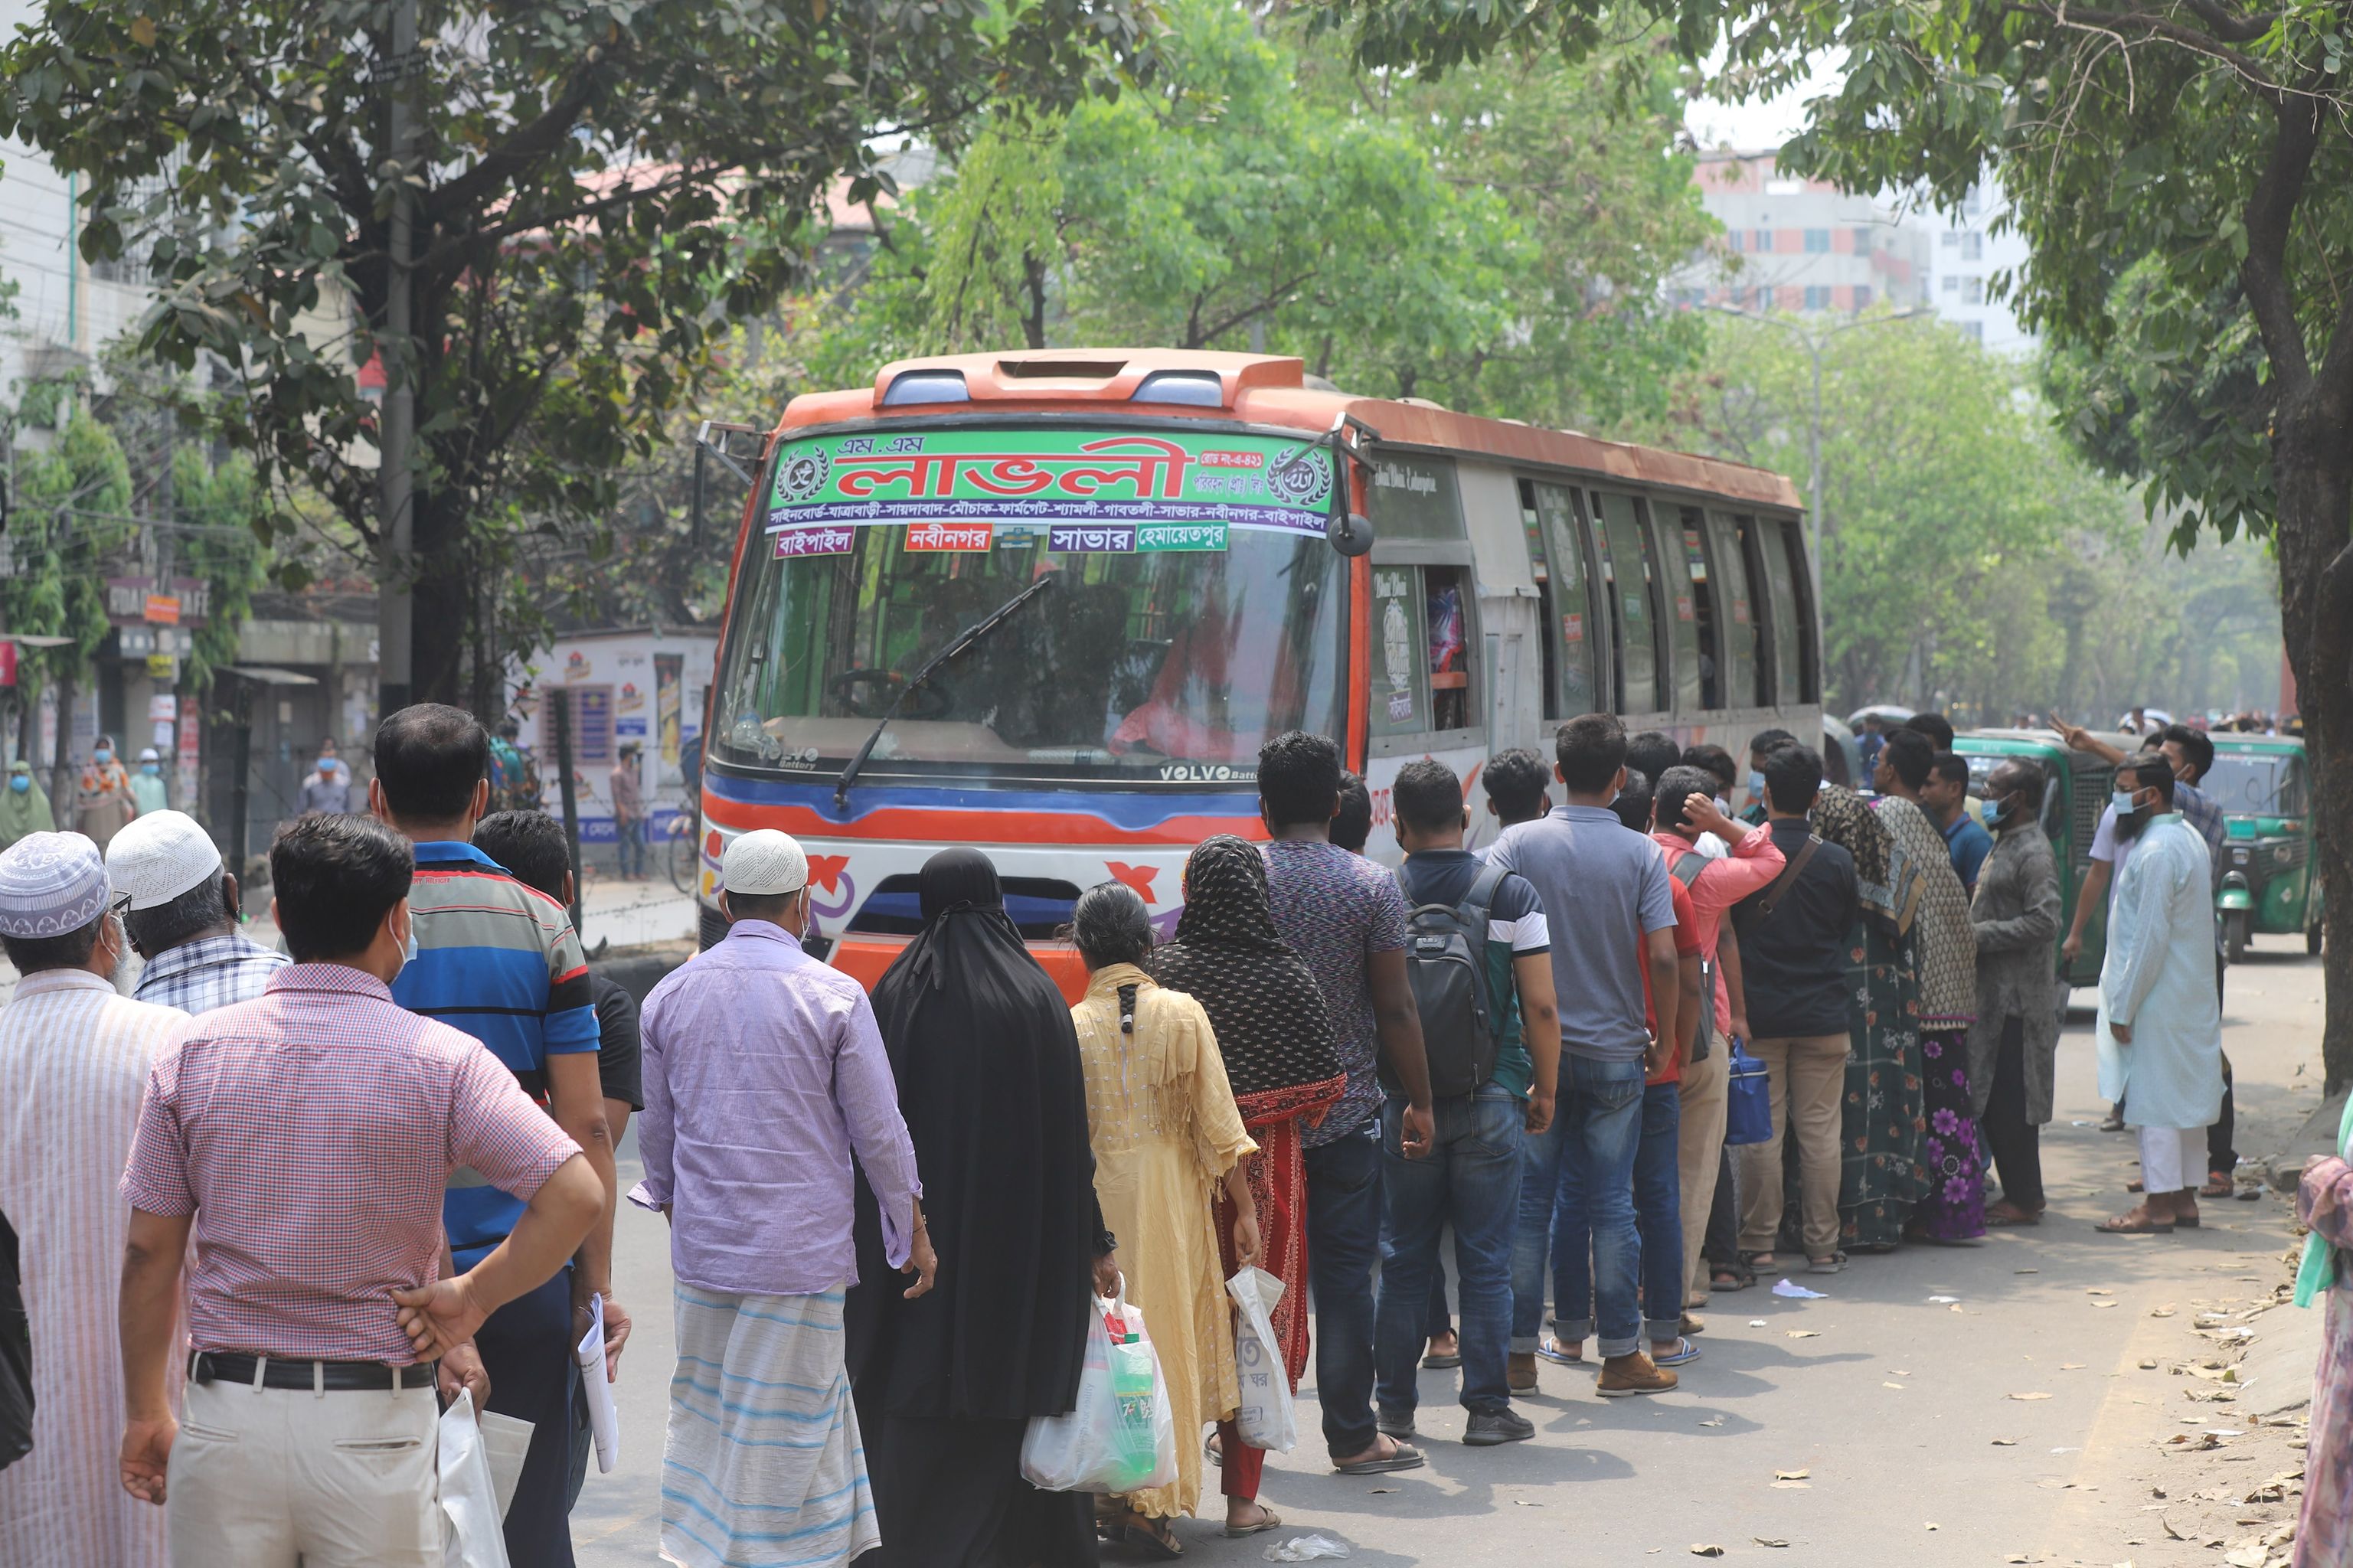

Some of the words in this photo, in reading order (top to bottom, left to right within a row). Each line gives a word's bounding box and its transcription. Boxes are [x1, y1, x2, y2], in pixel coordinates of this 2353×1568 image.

[833, 435, 1197, 498] লাভলী
[779, 528, 851, 554] বাইপাইল
[910, 524, 990, 548] নবীনগর
[1052, 528, 1133, 550] সাভার
[1138, 524, 1225, 547] হেমায়েতপুর
[779, 760, 816, 771] Battery
[1160, 766, 1230, 780] VOLVO
